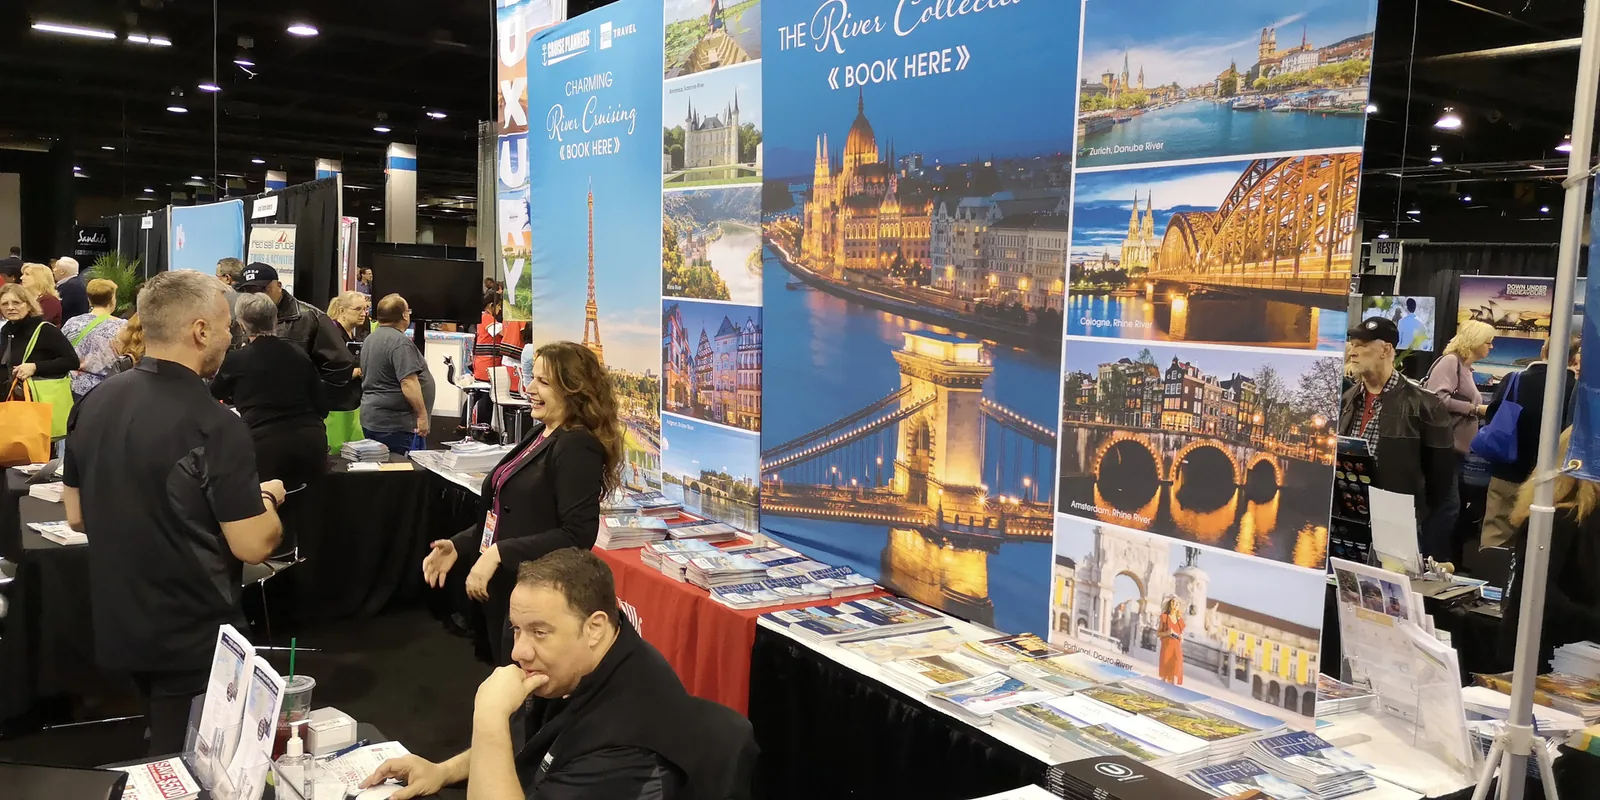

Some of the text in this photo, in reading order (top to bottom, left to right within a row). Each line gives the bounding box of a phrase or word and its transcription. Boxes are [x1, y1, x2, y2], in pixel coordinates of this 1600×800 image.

[613, 23, 637, 39] TRAVEL
[777, 22, 806, 51] THE
[810, 0, 887, 55] River
[844, 47, 952, 88] BOOK HERE
[565, 71, 613, 97] CHARMING
[546, 95, 637, 142] River Cruising
[566, 139, 613, 159] BOOK HERE
[1089, 141, 1164, 156] Zurich, Danube River
[77, 229, 107, 243] Sandals
[1506, 283, 1526, 291] DOWN
[1506, 289, 1547, 297] ENDEAVOURS
[1080, 317, 1153, 329] Cologne, Rhine River
[1070, 500, 1151, 524] Amsterdam, Rhine River
[1093, 650, 1115, 665] Douro
[1114, 658, 1134, 671] River
